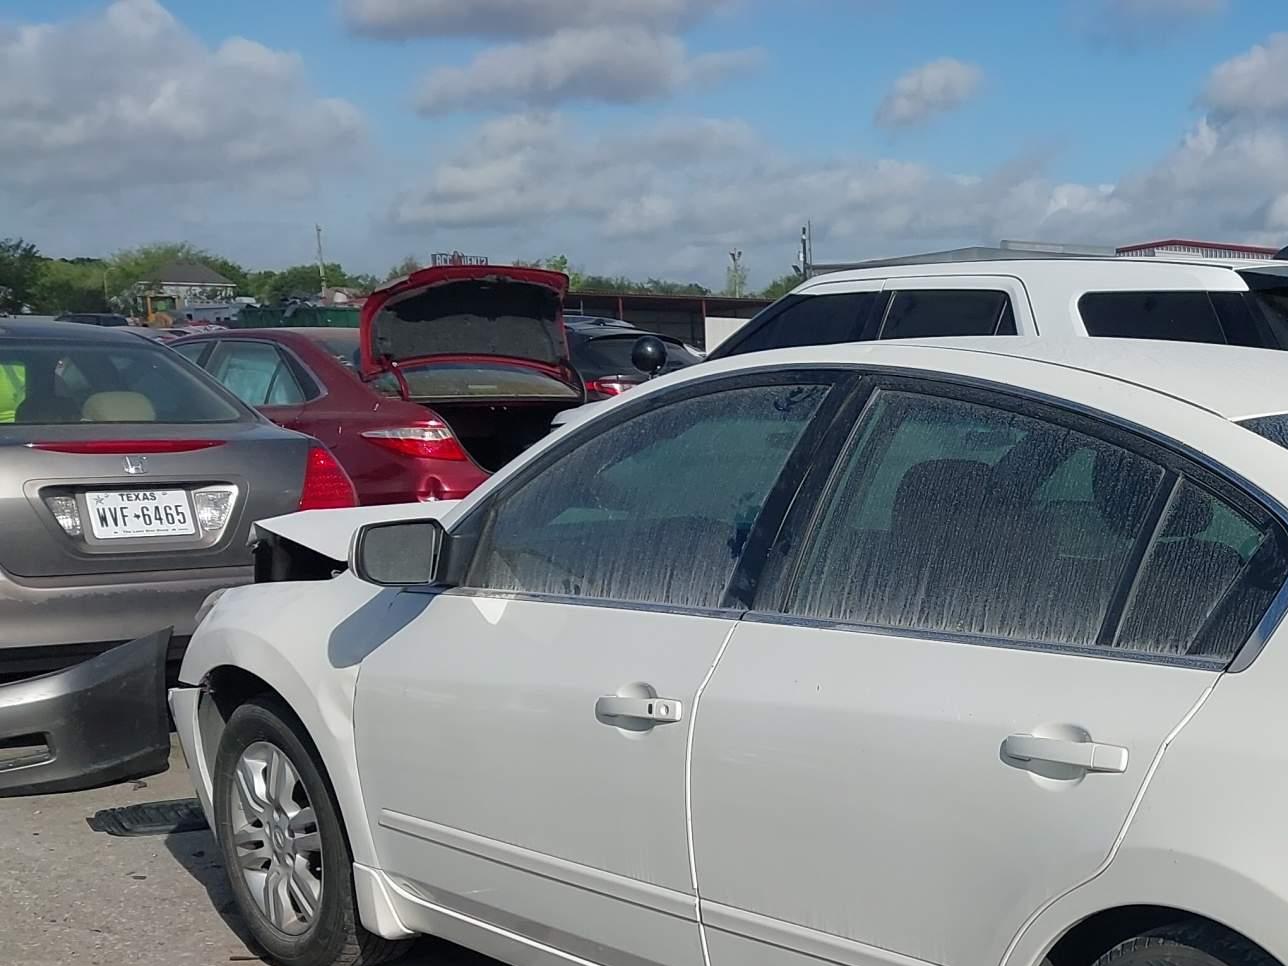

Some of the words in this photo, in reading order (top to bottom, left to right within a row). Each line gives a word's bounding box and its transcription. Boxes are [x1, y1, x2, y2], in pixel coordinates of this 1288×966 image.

[118, 492, 157, 502] TEXAS
[97, 506, 129, 528] WVF
[140, 505, 187, 526] 6465
